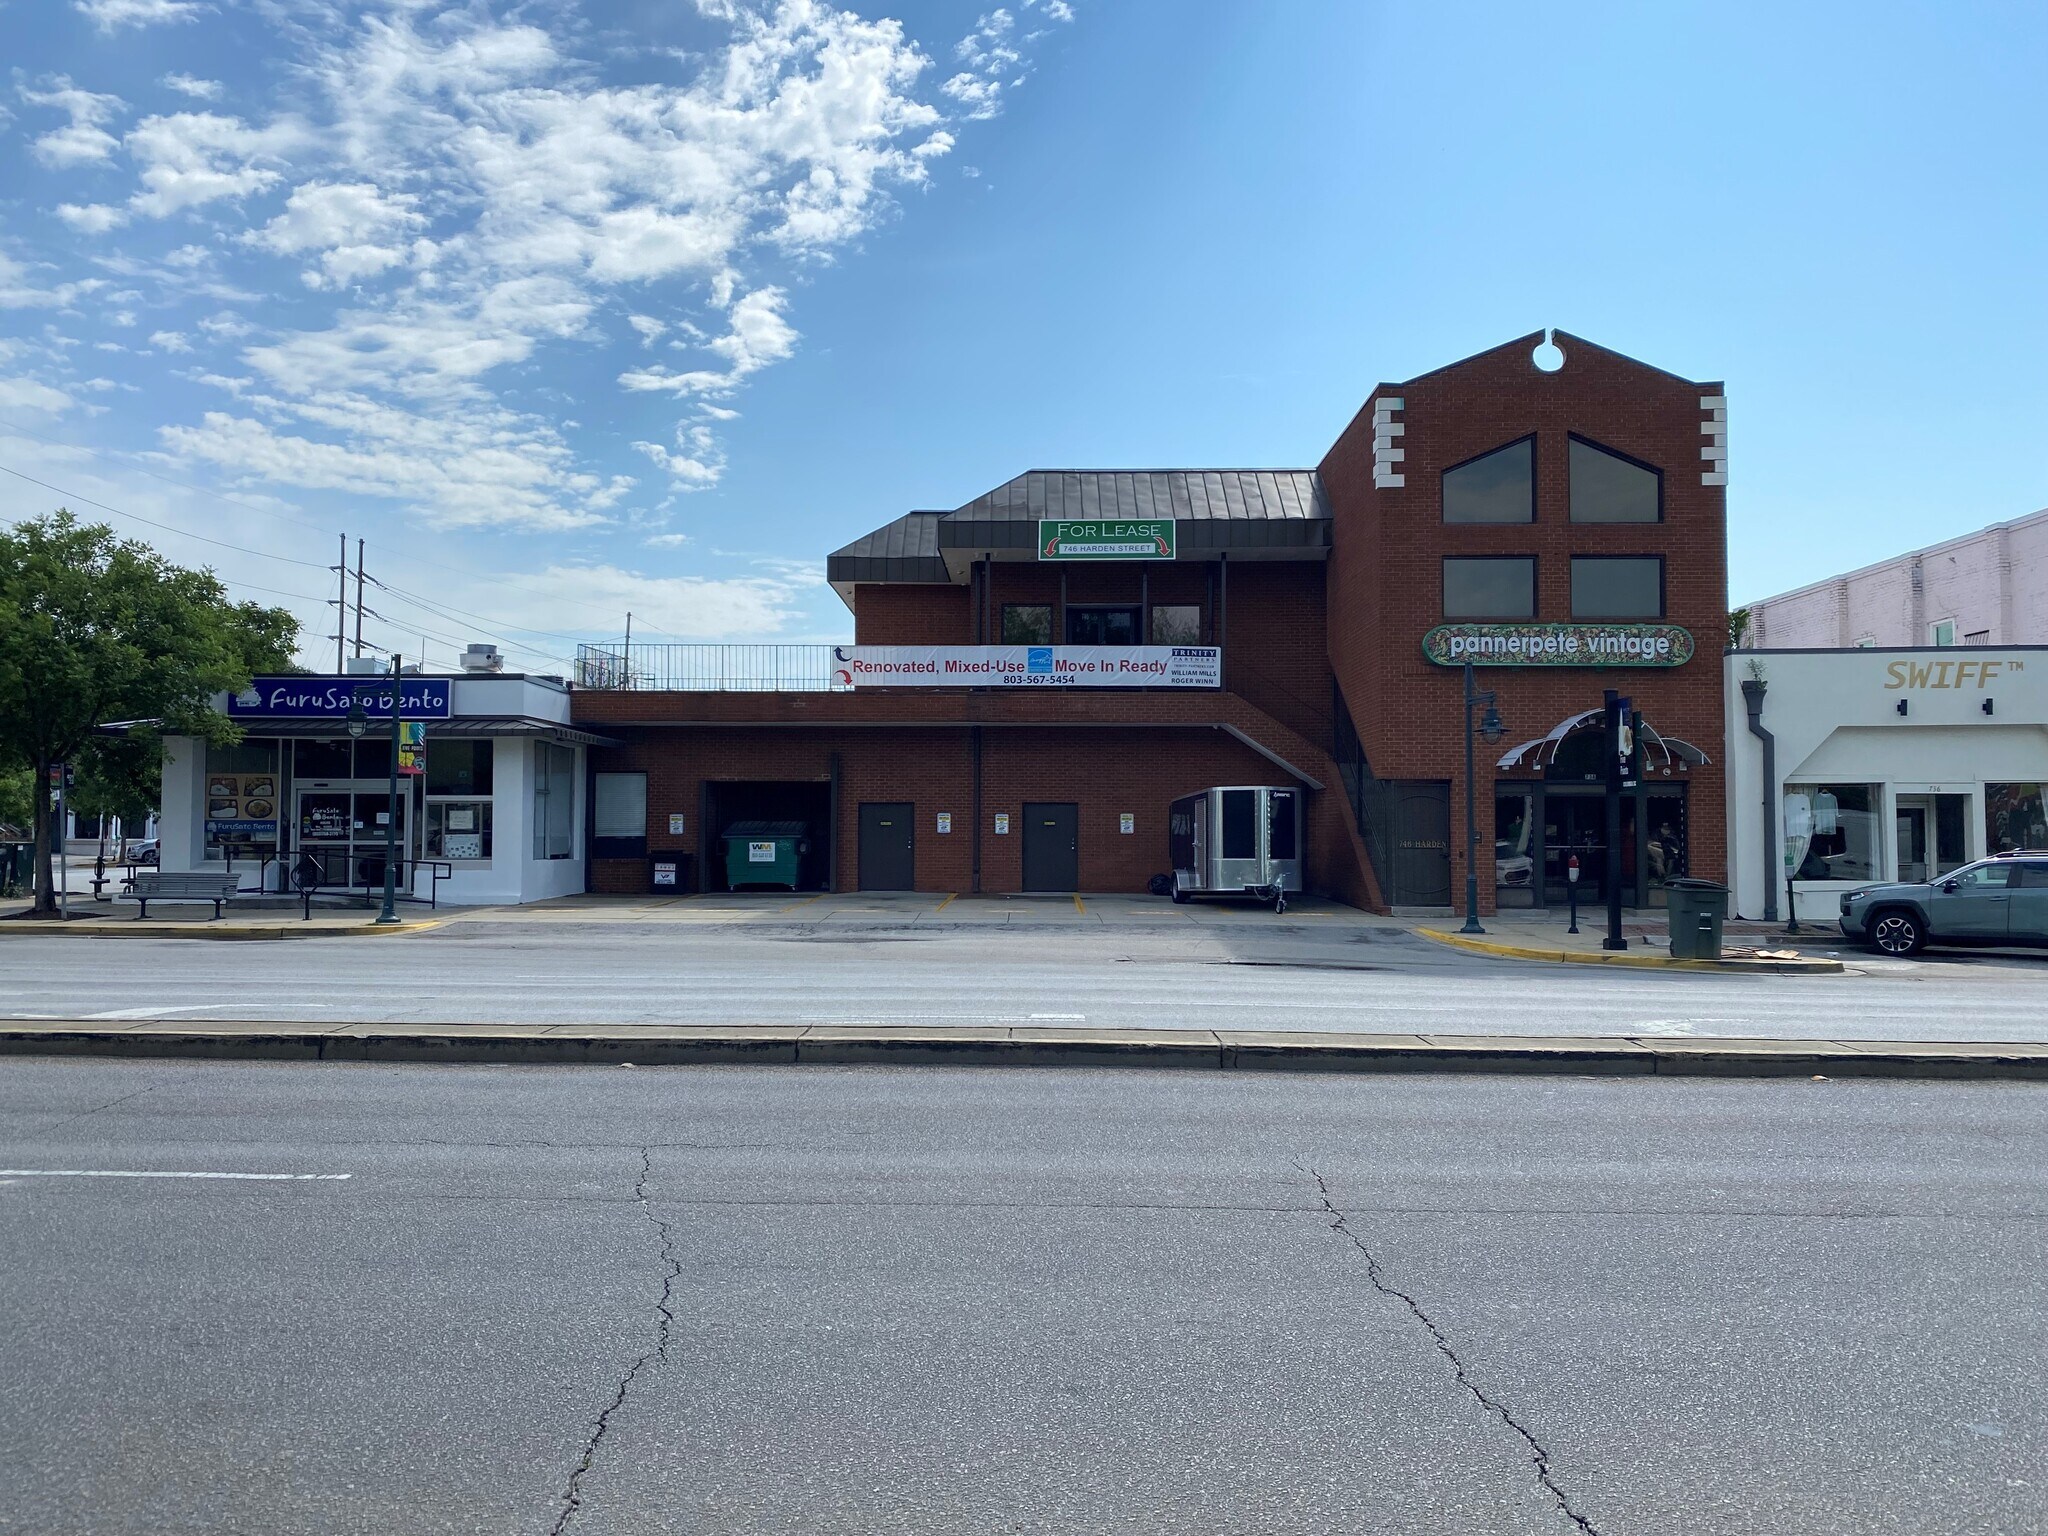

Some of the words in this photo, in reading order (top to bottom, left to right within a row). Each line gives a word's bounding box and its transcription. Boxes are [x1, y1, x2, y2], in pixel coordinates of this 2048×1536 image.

[1058, 523, 1097, 537] FOR
[1102, 523, 1161, 537] LEASE
[1450, 632, 1578, 657] pannerpete
[1588, 632, 1670, 660] vintage
[853, 660, 940, 674] Renovated,
[945, 660, 1025, 673] Mixed-Use
[1055, 660, 1096, 673] Move
[1101, 660, 1114, 672] In
[1120, 660, 1168, 675] Ready
[1003, 675, 1075, 684] 803-567-5454
[1884, 661, 2003, 689] SWIFF
[1415, 840, 1447, 848] HARDEN
